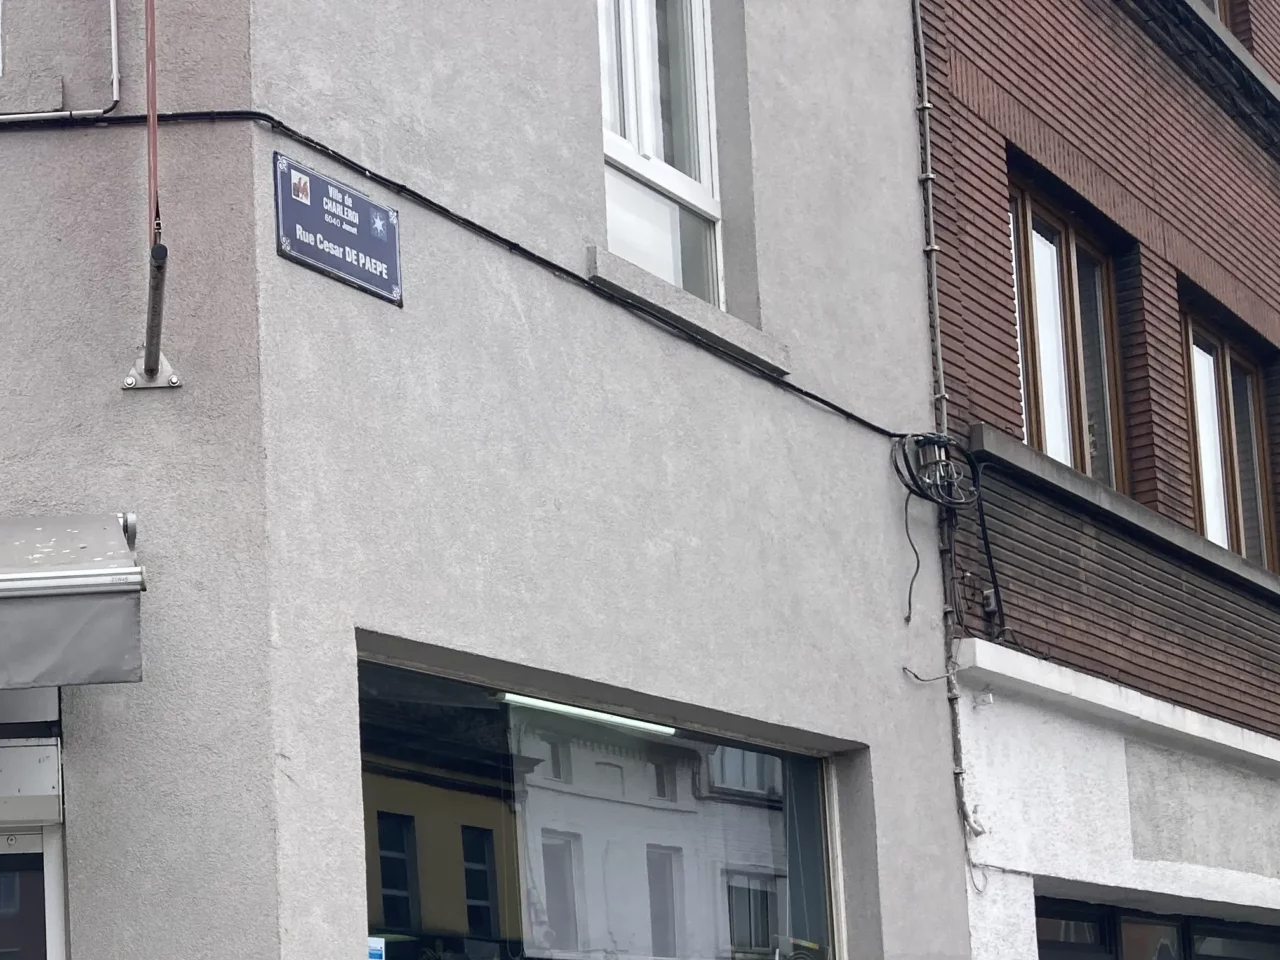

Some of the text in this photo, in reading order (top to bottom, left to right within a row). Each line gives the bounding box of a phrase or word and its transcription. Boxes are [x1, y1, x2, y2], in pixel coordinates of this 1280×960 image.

[328, 185, 353, 207] Ville de
[323, 197, 359, 225] CHARLEROI
[324, 213, 341, 228] 6040
[296, 224, 388, 280] Rue Cesar DE PAEPE
